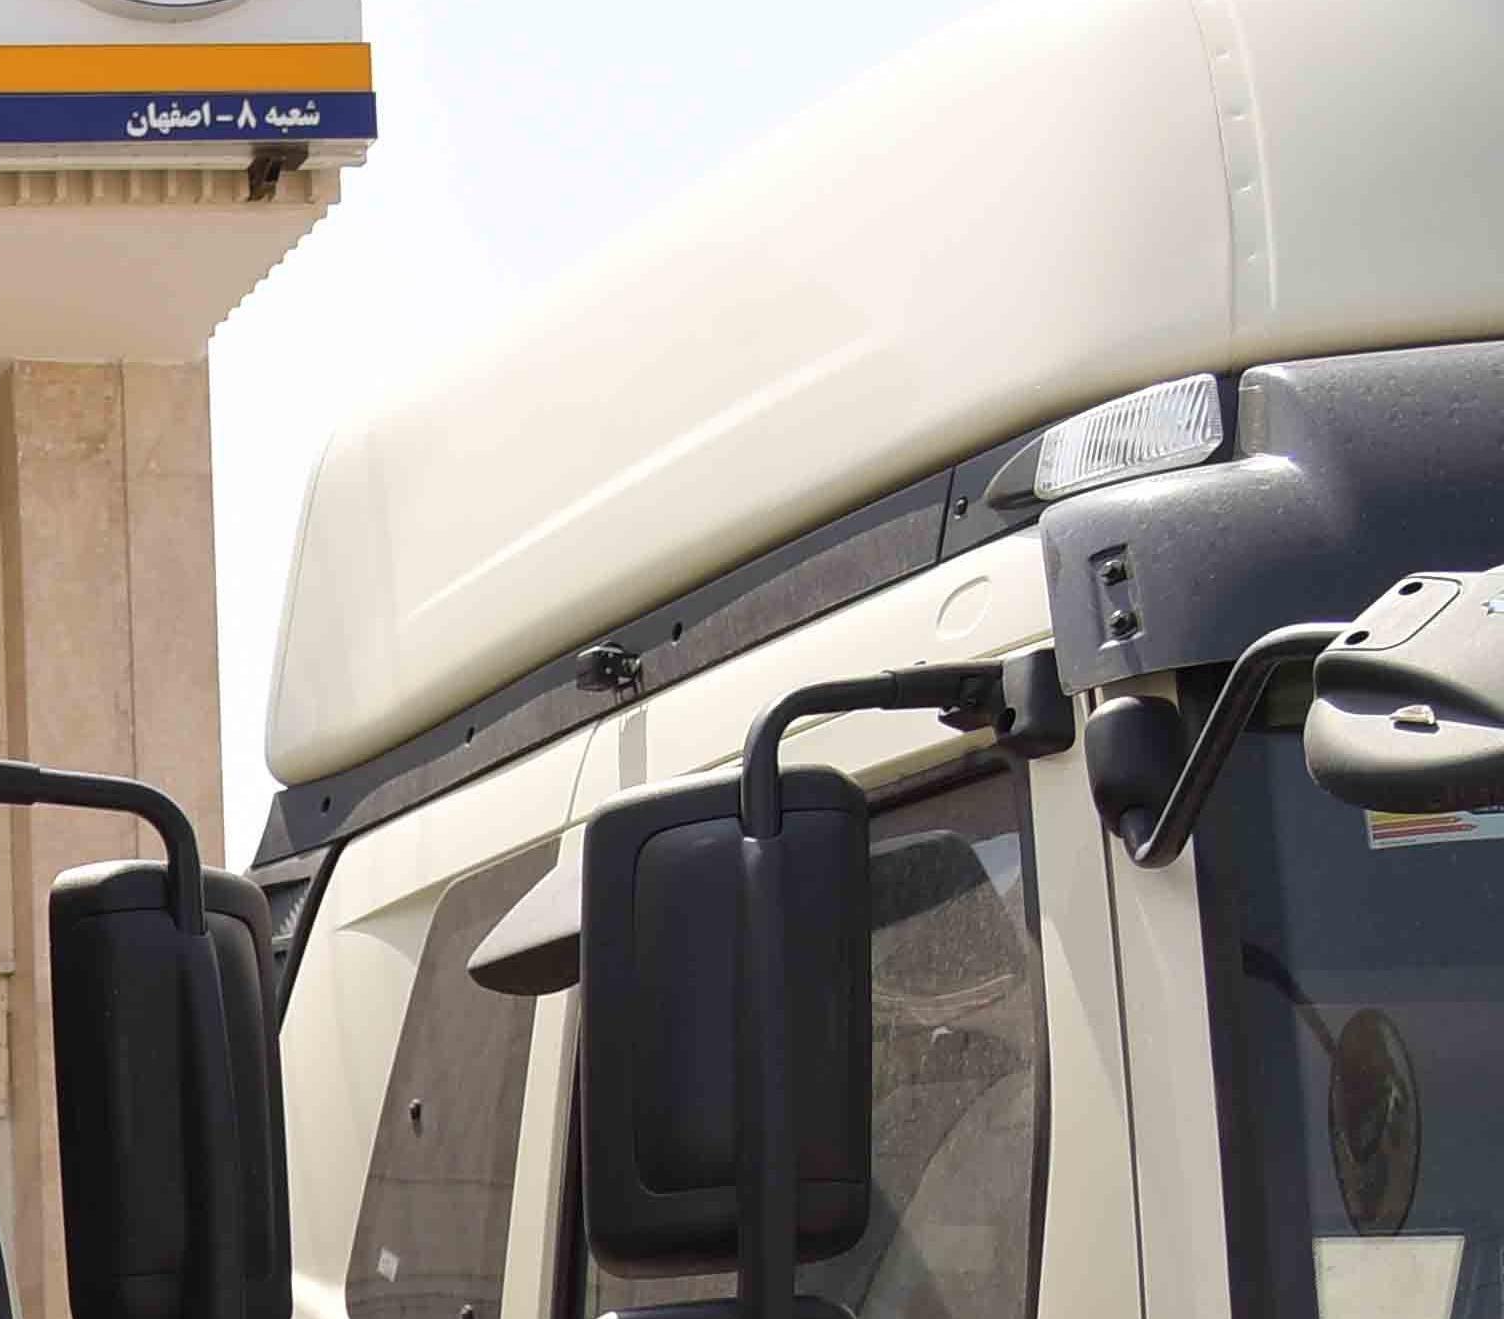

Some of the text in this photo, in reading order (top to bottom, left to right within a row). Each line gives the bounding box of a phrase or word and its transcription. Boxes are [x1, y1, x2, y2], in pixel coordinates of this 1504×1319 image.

[126, 100, 211, 137] اصفهان
[237, 99, 257, 130] ۸
[265, 100, 321, 132] شعبه
